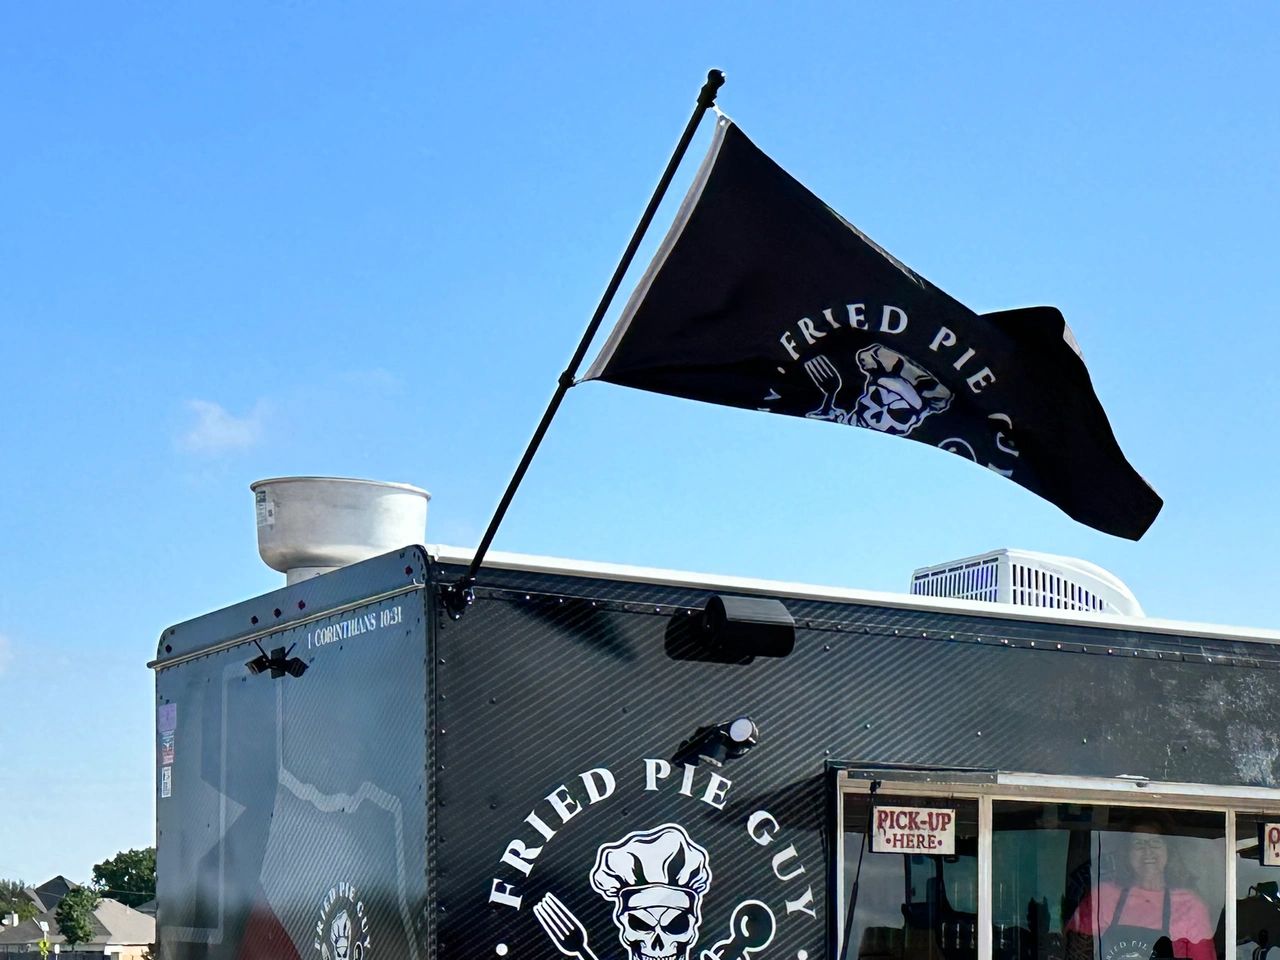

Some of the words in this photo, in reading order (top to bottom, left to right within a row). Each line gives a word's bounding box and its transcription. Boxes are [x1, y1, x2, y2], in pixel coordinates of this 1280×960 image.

[779, 302, 909, 361] FRIED
[929, 326, 996, 394] PIE
[315, 613, 376, 647] CORINTHIANS
[380, 606, 402, 628] 10:31
[488, 767, 616, 911] FRIED
[643, 758, 732, 810] PIE
[746, 810, 818, 919] GUY
[877, 810, 952, 832] PICK-UP
[892, 833, 937, 850] HERE
